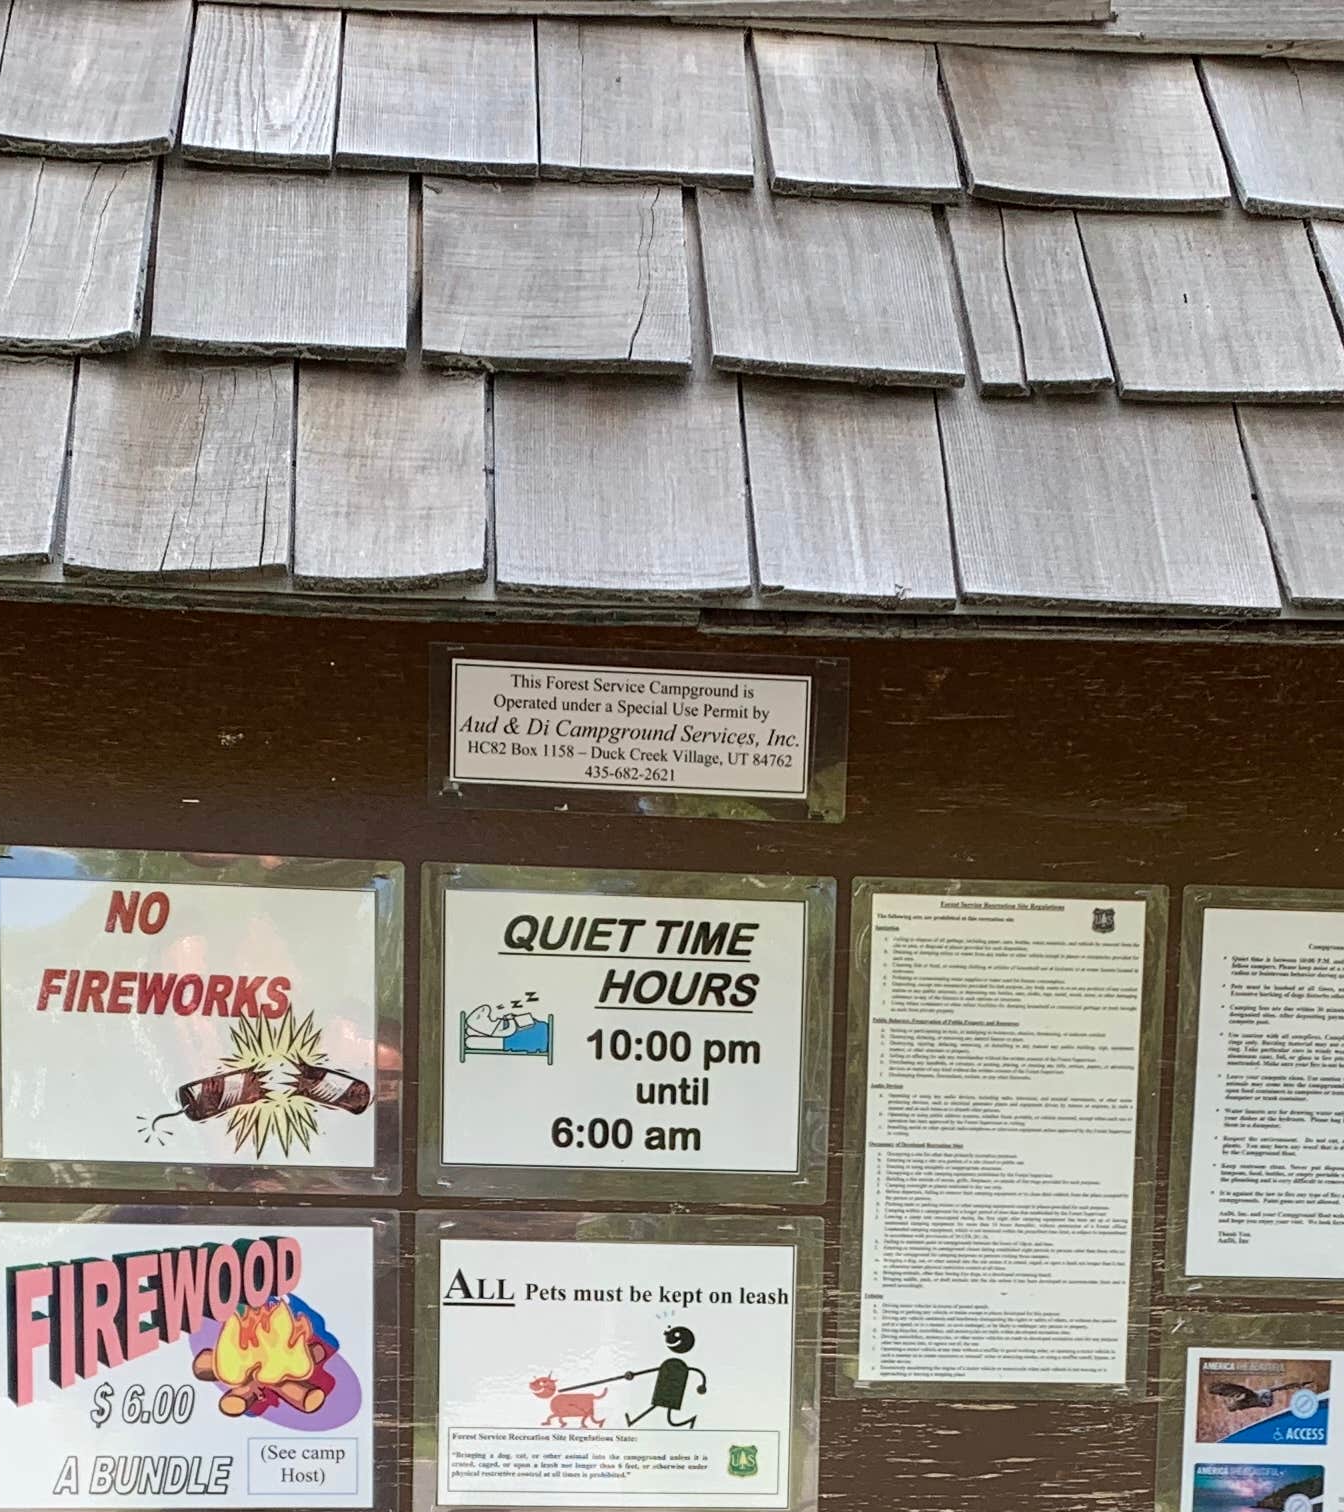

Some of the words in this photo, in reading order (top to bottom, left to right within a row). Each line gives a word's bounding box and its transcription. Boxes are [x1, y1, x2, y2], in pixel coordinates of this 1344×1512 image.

[511, 674, 541, 689] This
[547, 676, 588, 691] Forest
[593, 678, 644, 694] Service
[649, 681, 738, 700] Campground
[743, 685, 754, 699] is
[494, 694, 556, 712] Operated
[561, 698, 601, 713] under
[605, 703, 613, 713] a
[618, 700, 668, 718] Special
[673, 702, 698, 717] Use
[703, 704, 748, 719] Permit
[753, 706, 770, 723] by
[460, 715, 498, 734] Aud
[504, 717, 520, 735] &
[527, 718, 549, 736] Di
[556, 719, 677, 744] Campground
[680, 725, 759, 747] Services,
[767, 728, 800, 747] Inc.
[468, 740, 506, 755] HC82
[511, 743, 537, 757] Box
[544, 744, 574, 758] 1158
[591, 746, 625, 761] Duck
[630, 748, 668, 763] Creek
[672, 750, 723, 767] Village,
[728, 752, 749, 766] UT
[753, 754, 792, 768] 84762
[585, 766, 675, 781] 435-682-2621
[105, 890, 170, 935] NO
[504, 915, 646, 953] QUIET
[656, 919, 760, 957] TIME
[37, 969, 291, 1018] FIREWORKS
[599, 968, 760, 1008] HOURS
[587, 1028, 692, 1063] 10:00
[703, 1039, 761, 1072] pm
[637, 1078, 709, 1107] until
[551, 1117, 633, 1151] 6:00
[645, 1126, 701, 1152] am
[443, 1267, 515, 1300] ALL
[525, 1283, 567, 1301] Pets
[574, 1286, 623, 1303] must
[630, 1284, 653, 1303] be
[659, 1285, 703, 1309] kept
[708, 1290, 733, 1304] on
[739, 1285, 790, 1306] leash
[6, 1236, 302, 1407] FIREWOOD
[122, 1384, 195, 1424] 6.00
[1285, 1427, 1325, 1441] ACCESS
[260, 1445, 297, 1464] (See
[301, 1446, 346, 1465] camp
[53, 1456, 79, 1495] A
[89, 1456, 233, 1495] BUNDLE
[280, 1467, 326, 1486] Host)
